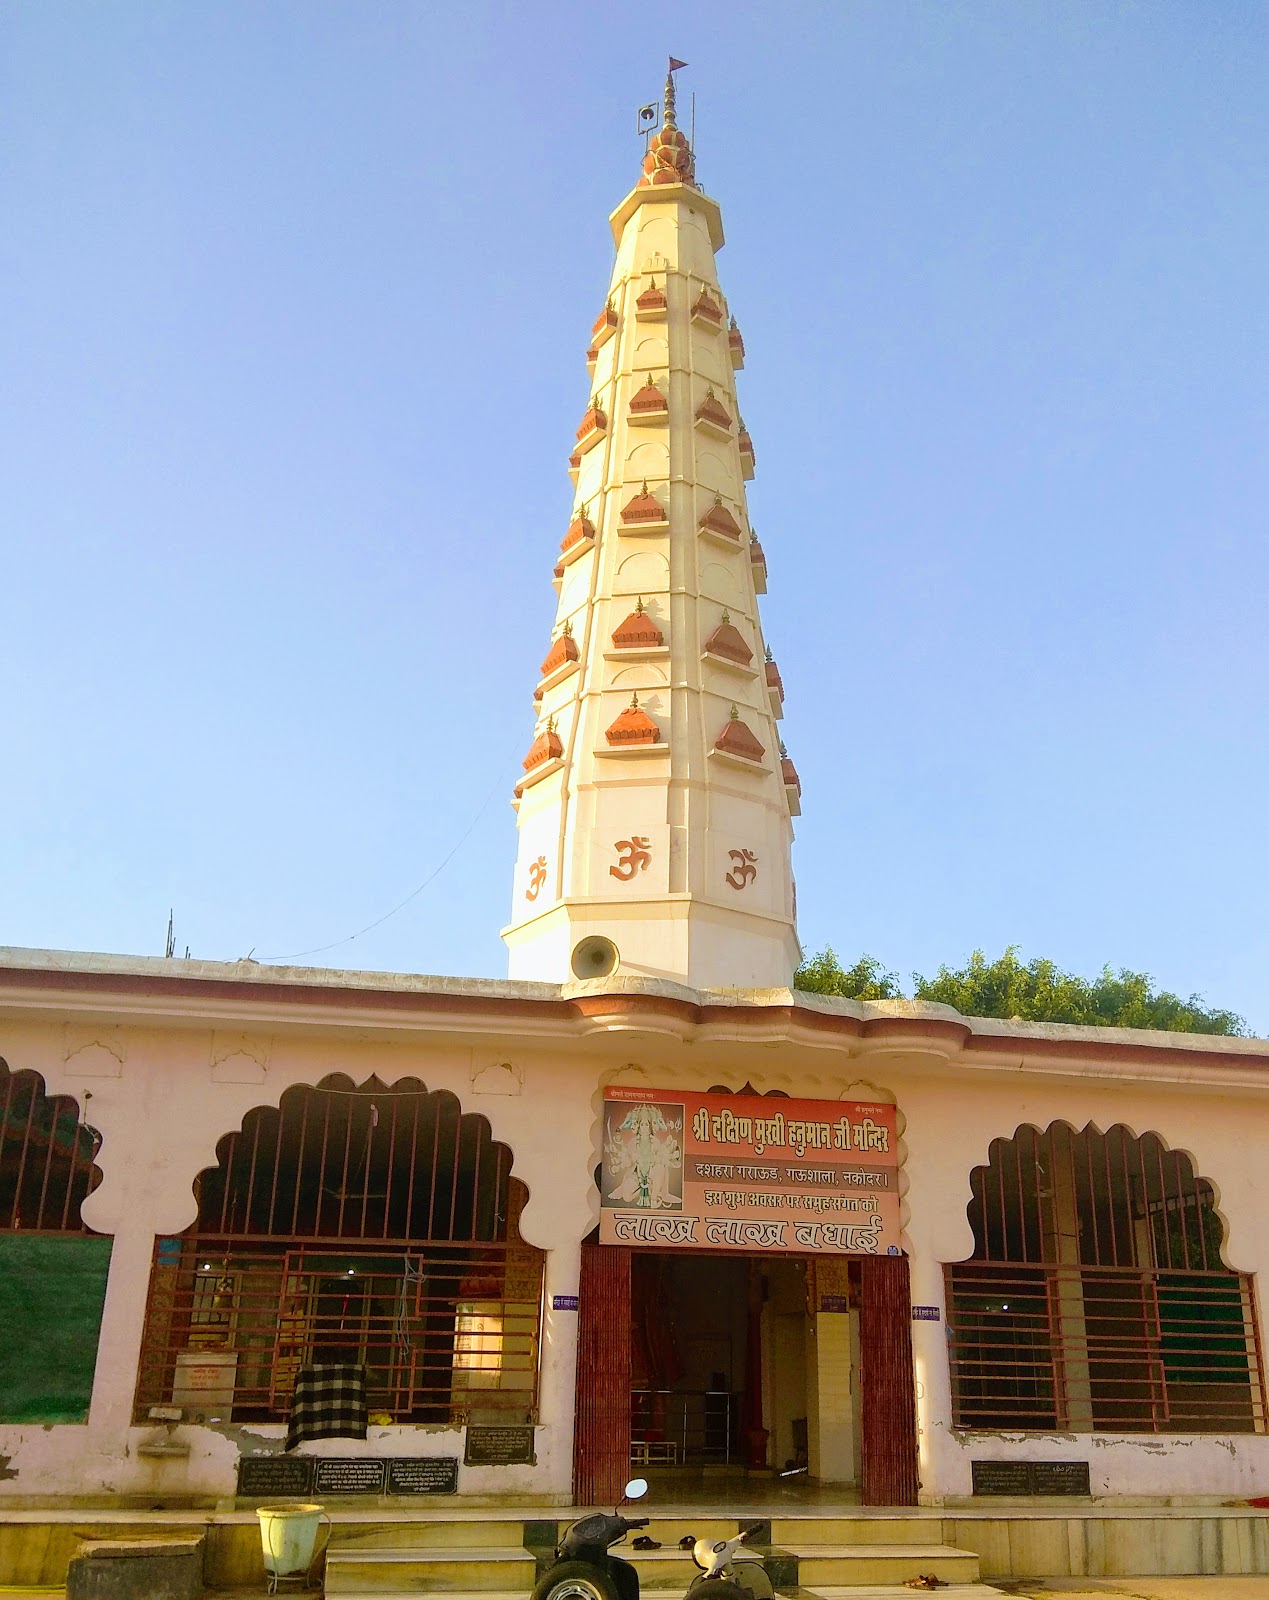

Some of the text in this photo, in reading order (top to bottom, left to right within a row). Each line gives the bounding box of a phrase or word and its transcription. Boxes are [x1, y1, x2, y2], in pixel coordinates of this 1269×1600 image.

[692, 1107, 890, 1157] श्री दक्षिण मुखी हनुमान जी मन्दिर
[695, 1162, 734, 1179] दशहरा
[785, 1167, 840, 1187] गऊशाला,
[704, 1189, 723, 1206] इस
[724, 1191, 746, 1210] शुभ
[747, 1192, 784, 1208] अवसर
[785, 1194, 802, 1209] पर
[831, 1193, 860, 1212] संगत
[860, 1194, 879, 1213] को
[614, 1213, 884, 1254] लाख लाख बधाई
